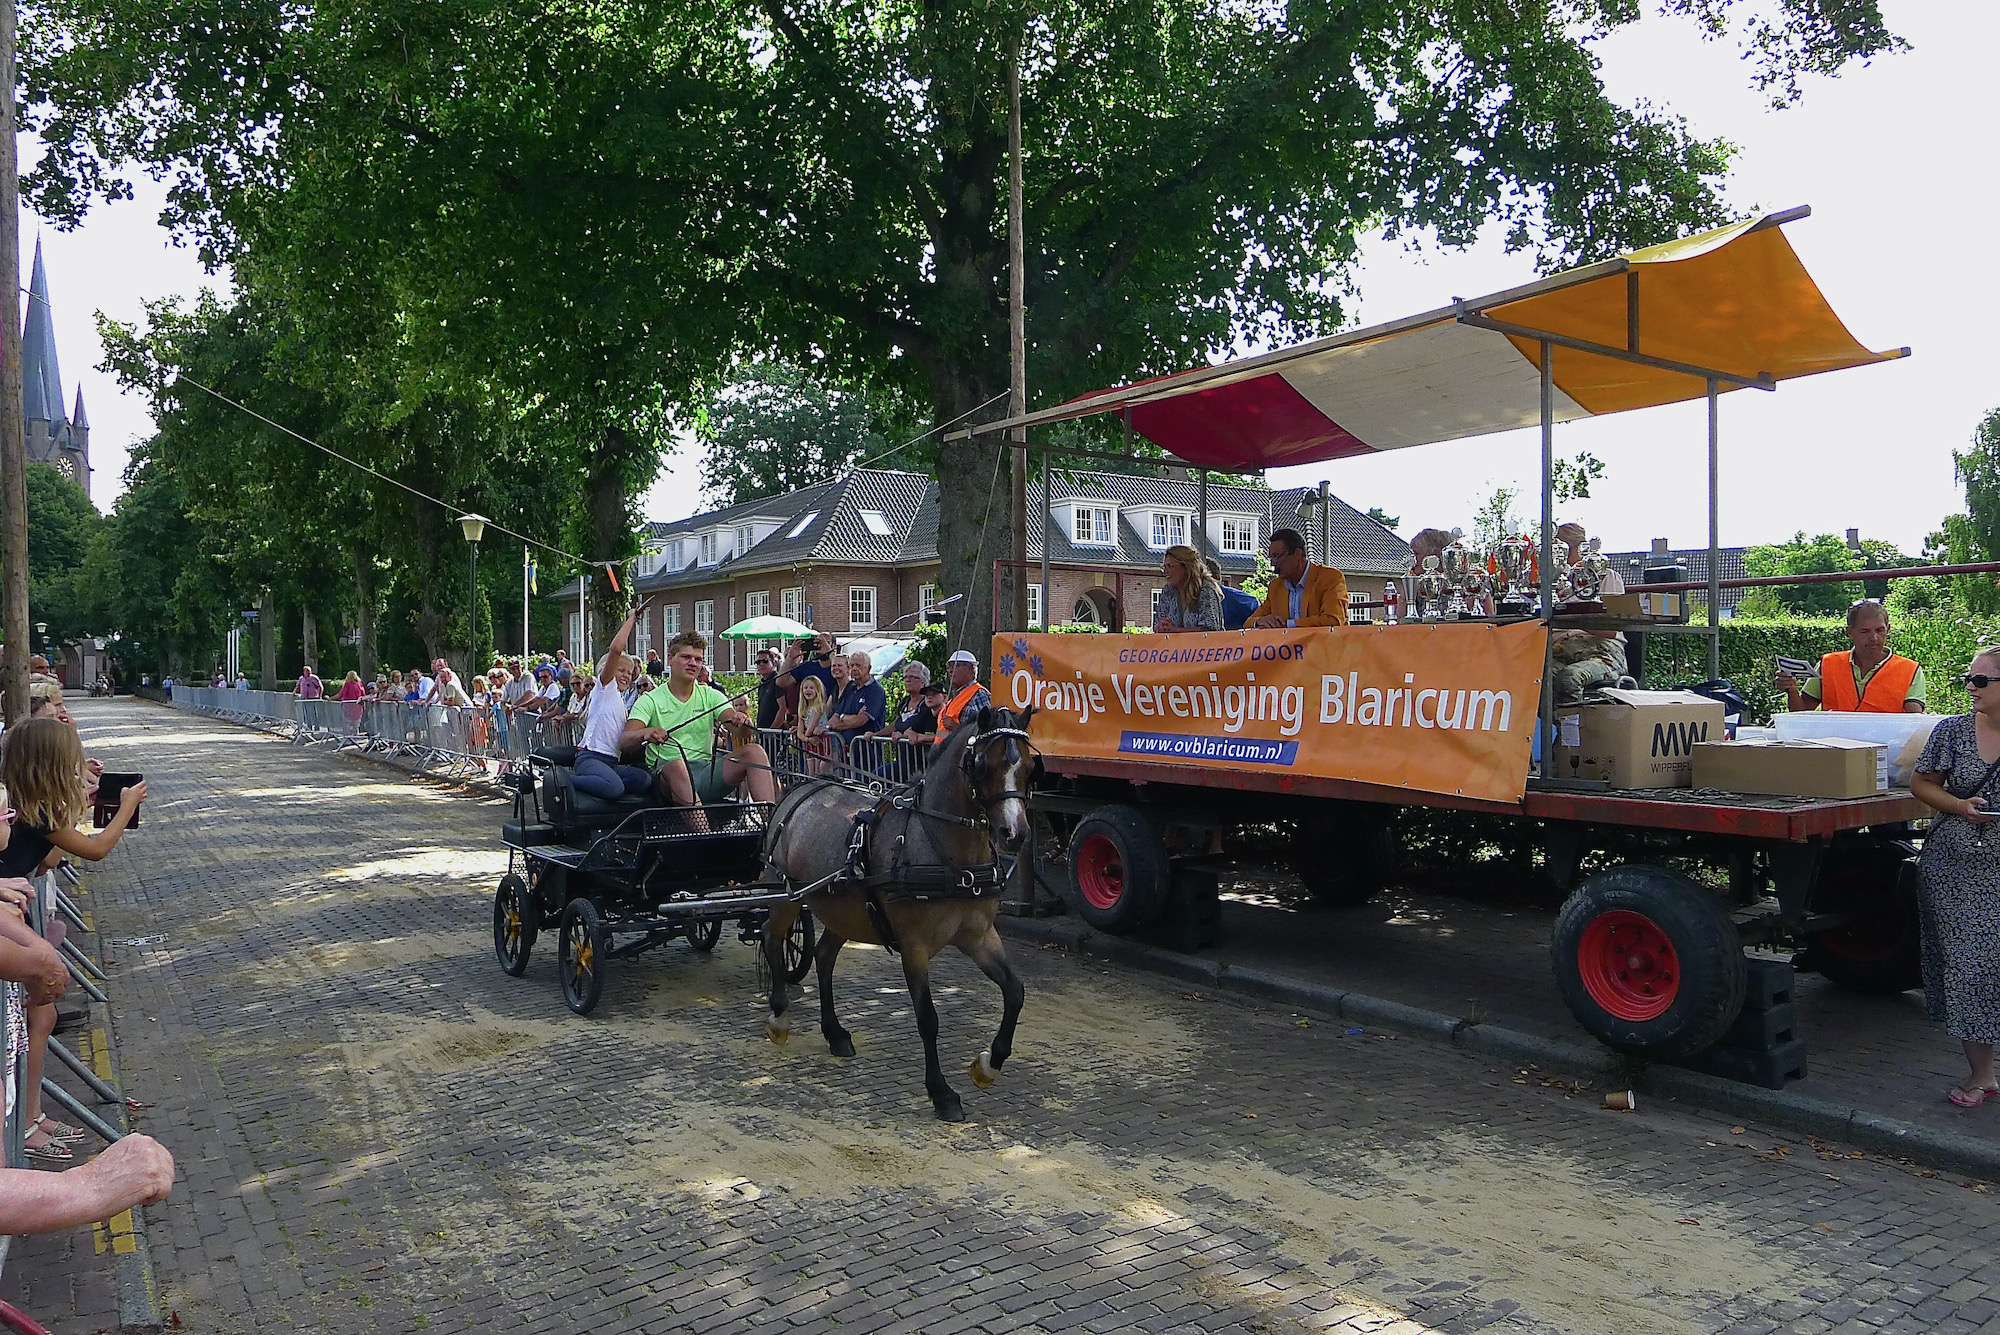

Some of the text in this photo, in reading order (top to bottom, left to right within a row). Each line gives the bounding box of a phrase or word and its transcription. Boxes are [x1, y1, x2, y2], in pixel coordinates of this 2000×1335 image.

[1119, 644, 1304, 664] GEORGANISEERD DOOR
[1011, 669, 1106, 724] Oranje
[1110, 672, 1304, 736] Vereniging
[1319, 671, 1511, 732] Blaricum
[1132, 735, 1284, 760] www.ovblaricum.nl
